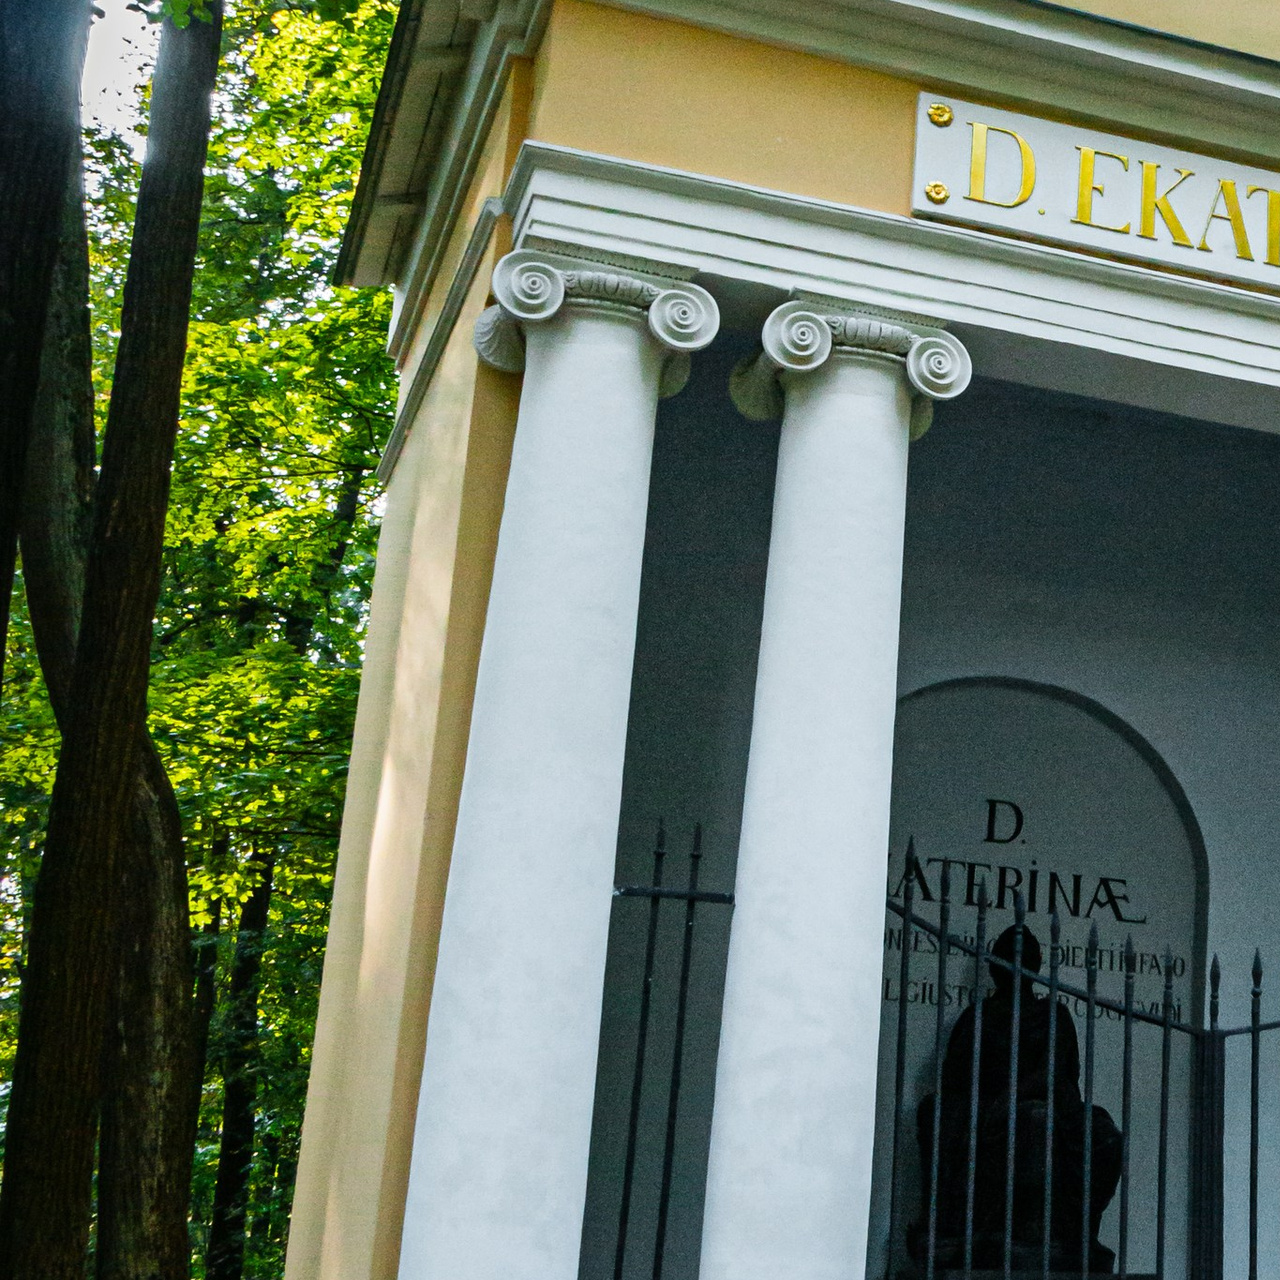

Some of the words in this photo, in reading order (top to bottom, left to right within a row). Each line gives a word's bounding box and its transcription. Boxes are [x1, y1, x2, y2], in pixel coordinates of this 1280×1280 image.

[963, 121, 1046, 216] D.
[982, 798, 1027, 845] D.
[886, 853, 1147, 924] ATERINÆ
